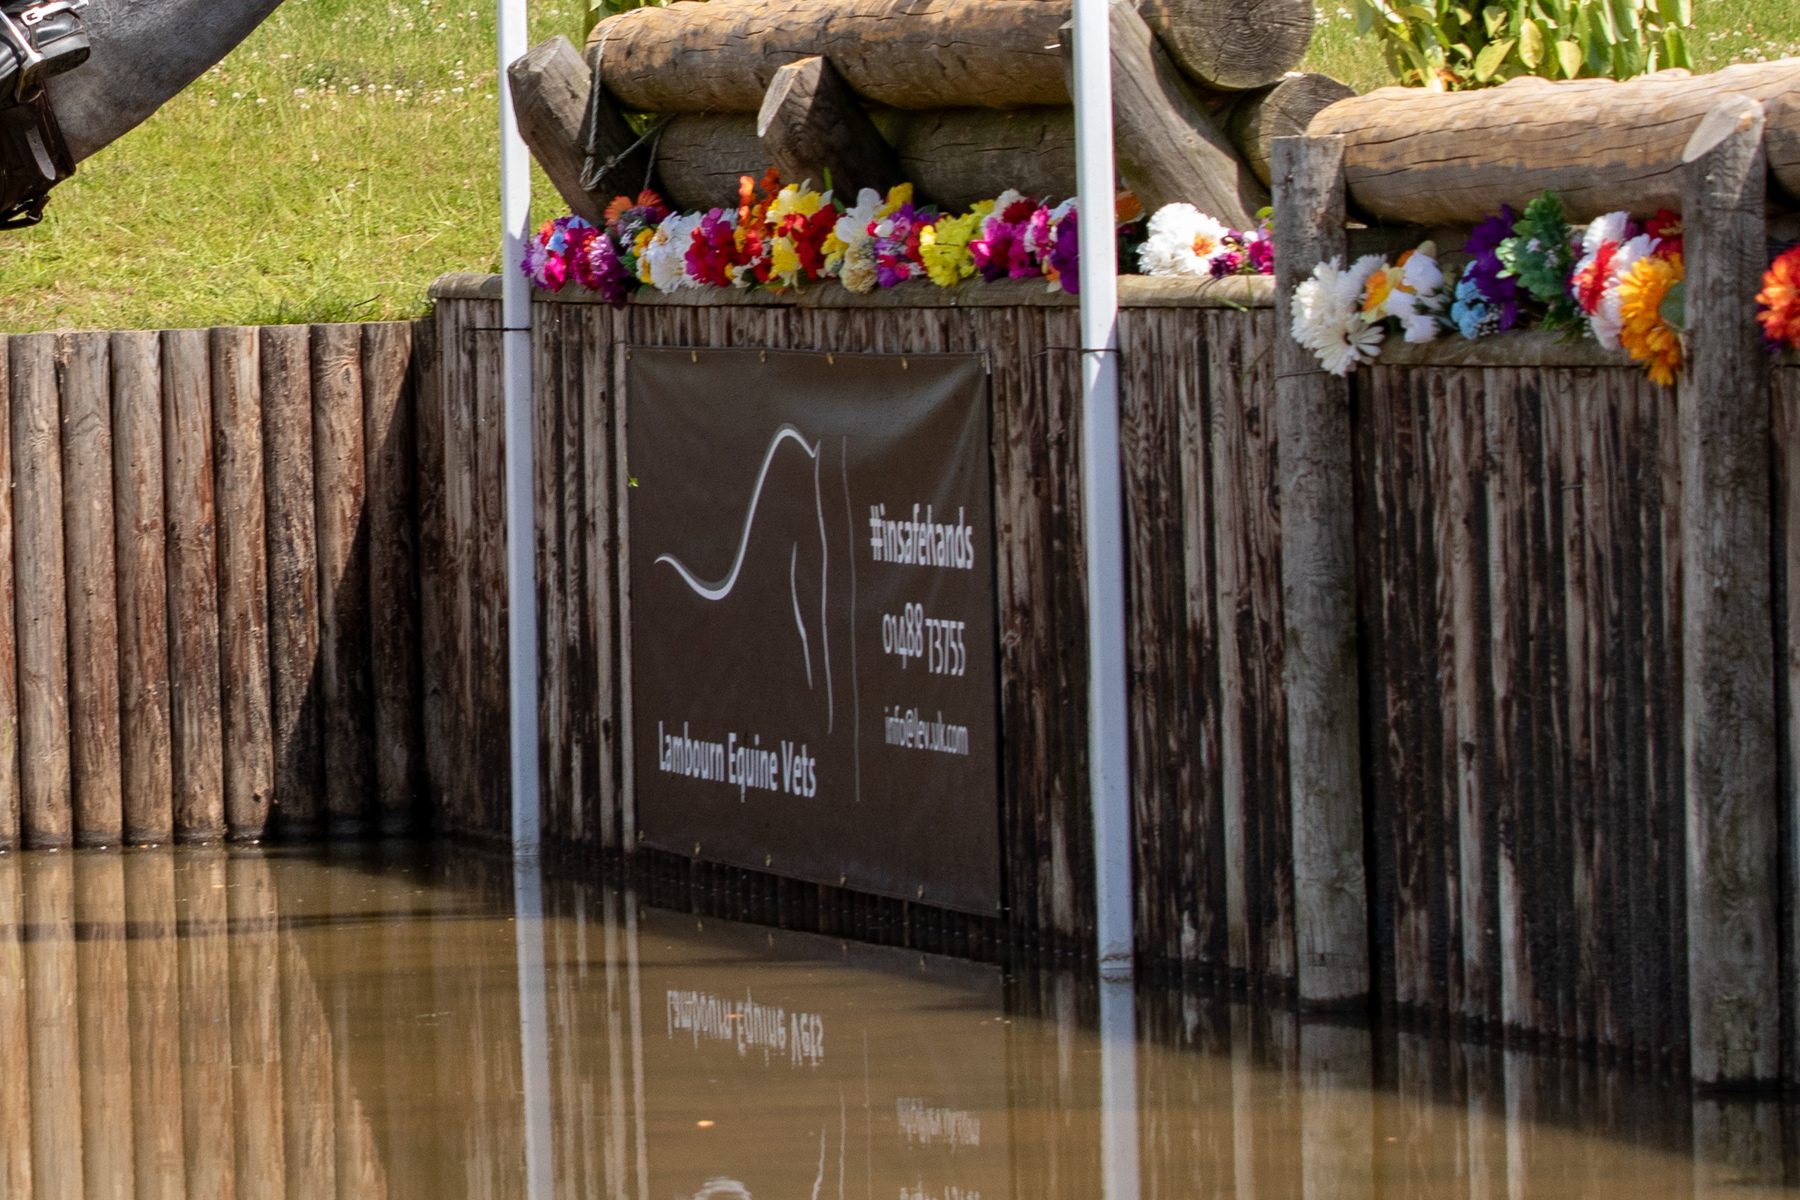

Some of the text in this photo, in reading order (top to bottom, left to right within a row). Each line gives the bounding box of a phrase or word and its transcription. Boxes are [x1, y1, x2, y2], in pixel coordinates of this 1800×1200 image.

[869, 502, 974, 570] #insafehands
[882, 601, 966, 677] 01488 73755
[658, 719, 817, 804] Lambourn Equine Vets
